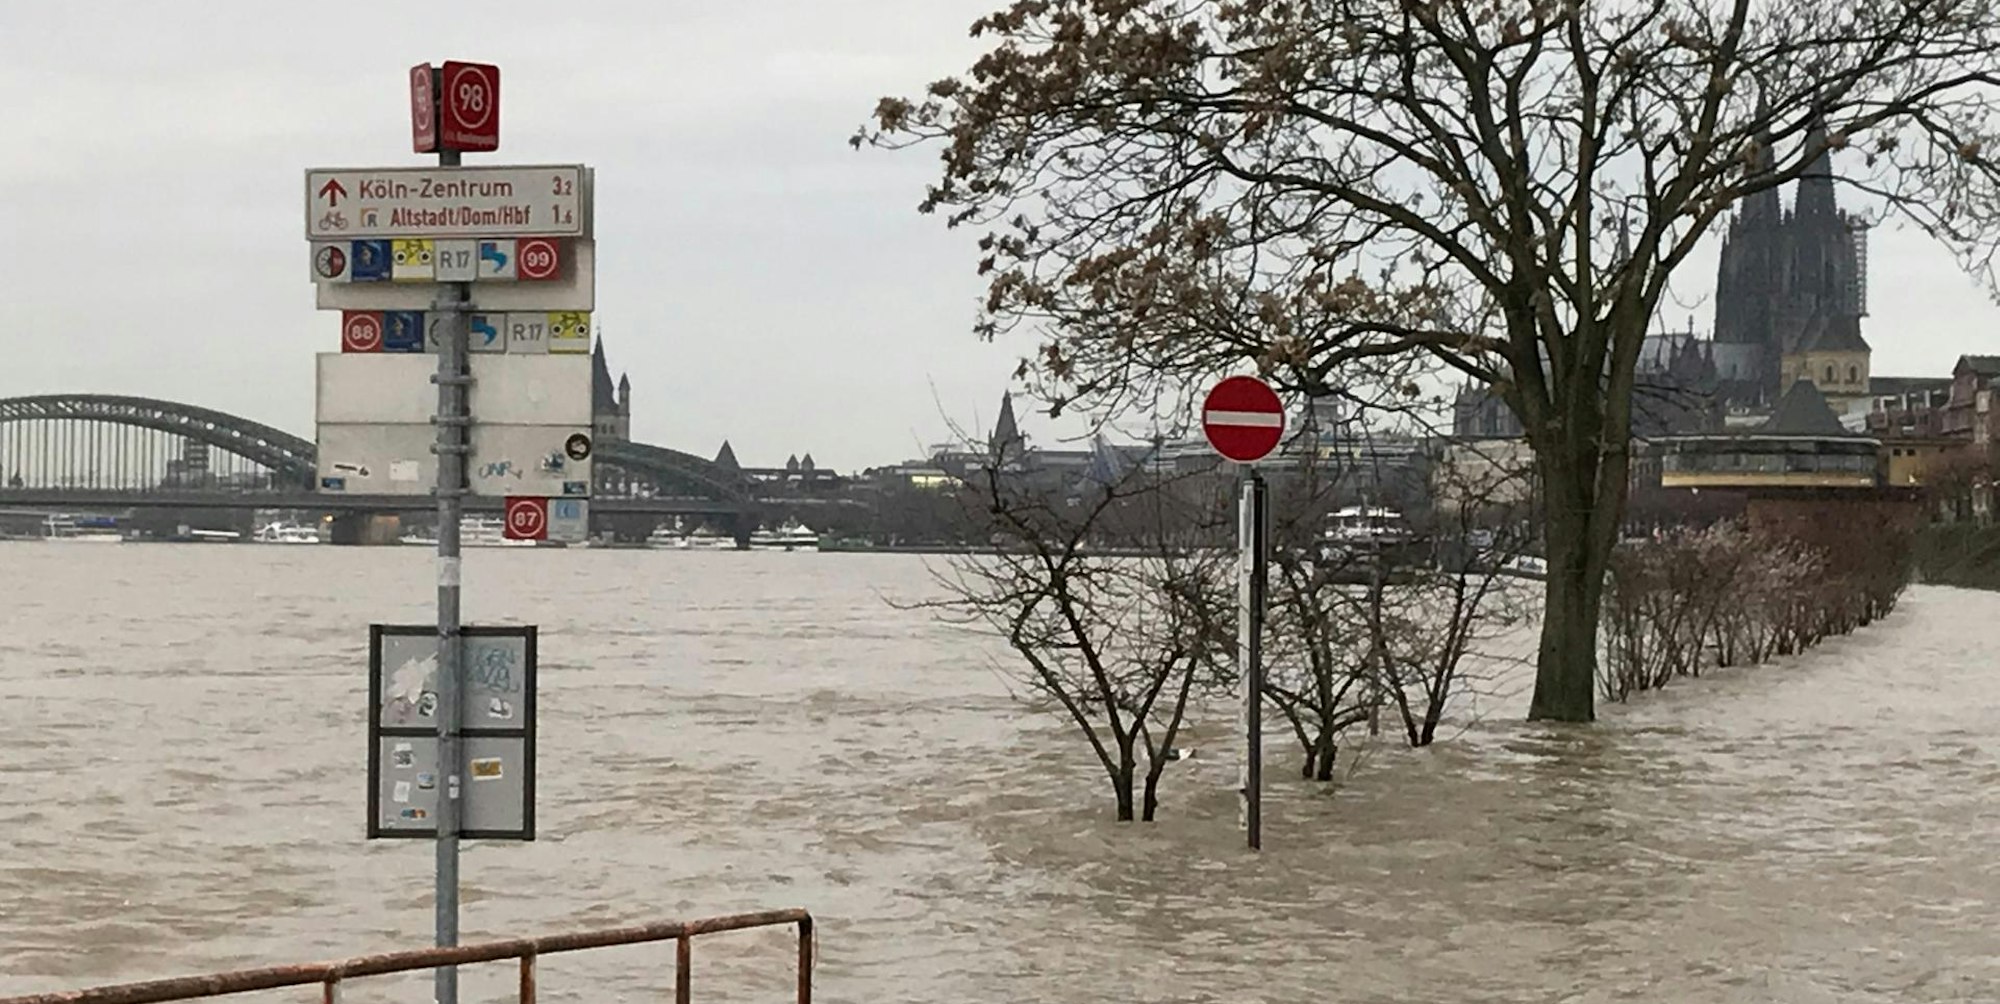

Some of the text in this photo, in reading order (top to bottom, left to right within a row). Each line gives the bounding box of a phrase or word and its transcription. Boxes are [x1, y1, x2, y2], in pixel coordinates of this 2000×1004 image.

[460, 83, 483, 111] 98
[360, 178, 513, 199] Köln-Zentrum
[390, 205, 531, 227] Altstadt/Dom/Hbf
[440, 251, 470, 269] R 17
[527, 252, 550, 267] 99
[352, 324, 374, 340] 88
[513, 323, 543, 341] R 17
[515, 512, 537, 527] 87
